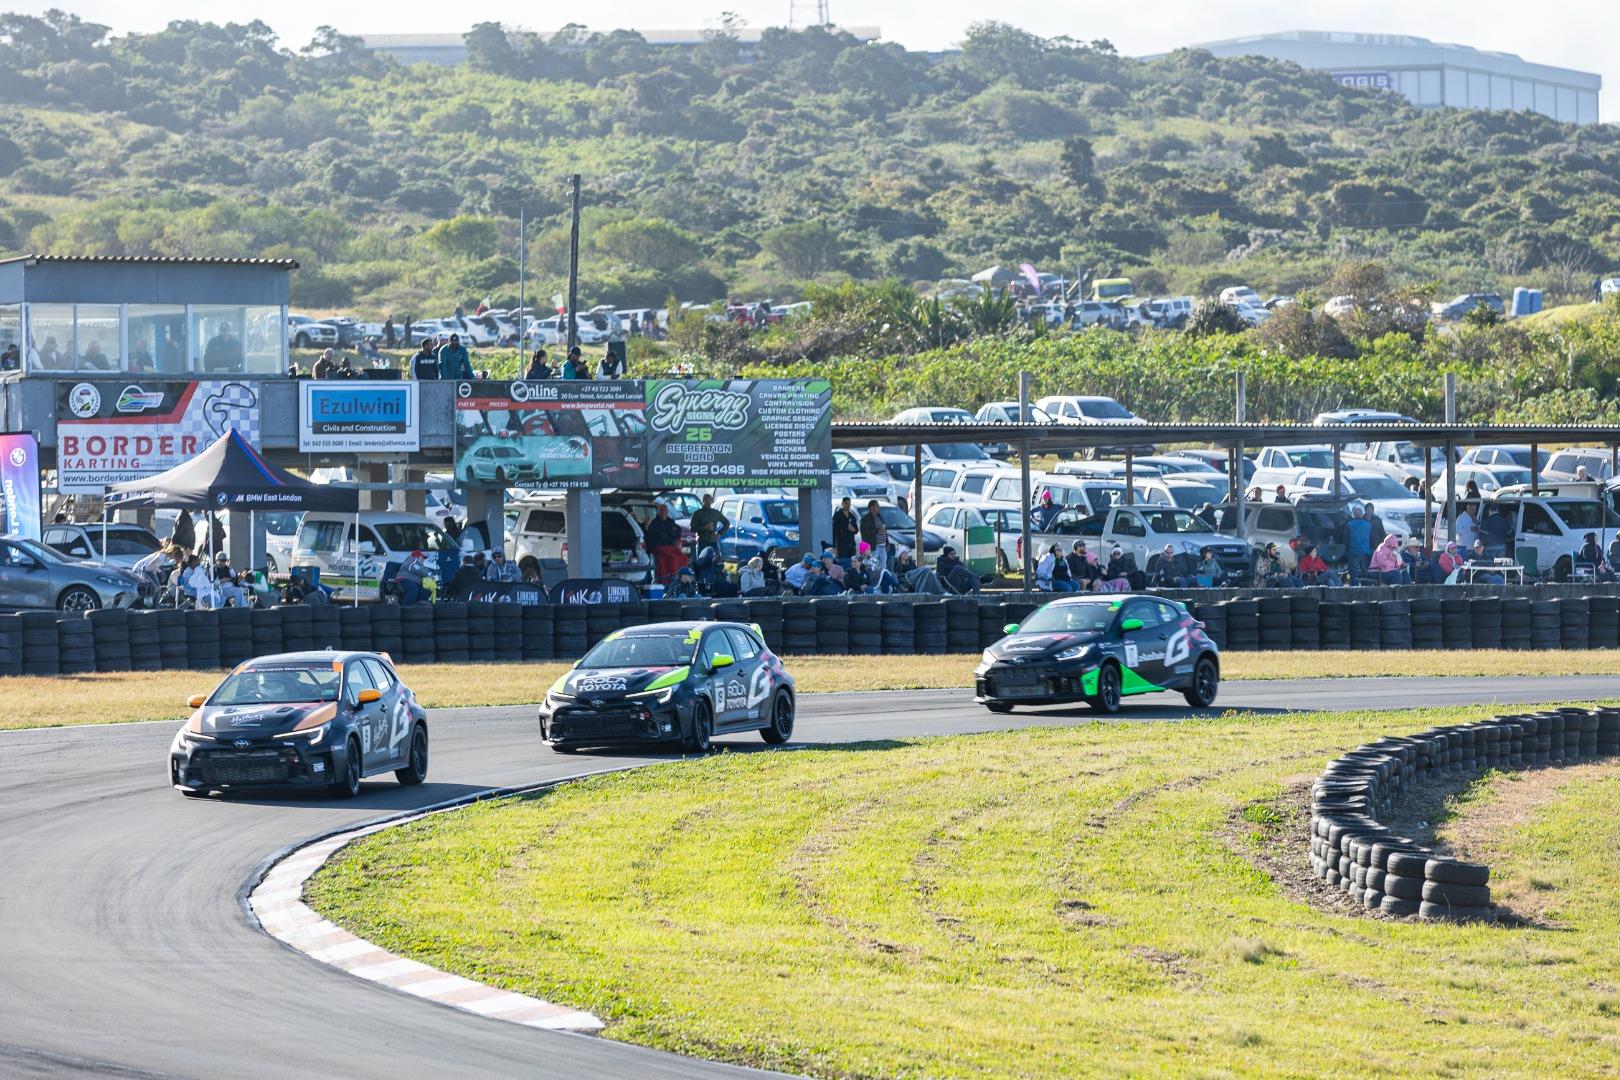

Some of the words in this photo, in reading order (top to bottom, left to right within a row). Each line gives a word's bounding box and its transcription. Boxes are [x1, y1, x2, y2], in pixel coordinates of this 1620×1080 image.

[320, 397, 401, 416] Ezulwini
[651, 383, 751, 433] Synergy
[687, 411, 715, 420] SIGNS
[322, 424, 340, 432] Civils
[341, 424, 354, 432] and
[355, 424, 397, 432] Construction
[686, 427, 712, 441] 26
[63, 435, 198, 456] BORDER
[666, 444, 732, 453] RECREATION
[684, 453, 714, 462] ROAD
[63, 458, 141, 469] KARTING
[653, 465, 680, 475] 043
[682, 465, 708, 475] 722
[710, 465, 745, 475] 0496
[663, 478, 818, 487] WWW.SYNERGYSIGNS.CO.ZA
[246, 493, 263, 501] BMW
[263, 493, 278, 501] East
[278, 493, 302, 501] London
[578, 683, 627, 691] TOYOTA
